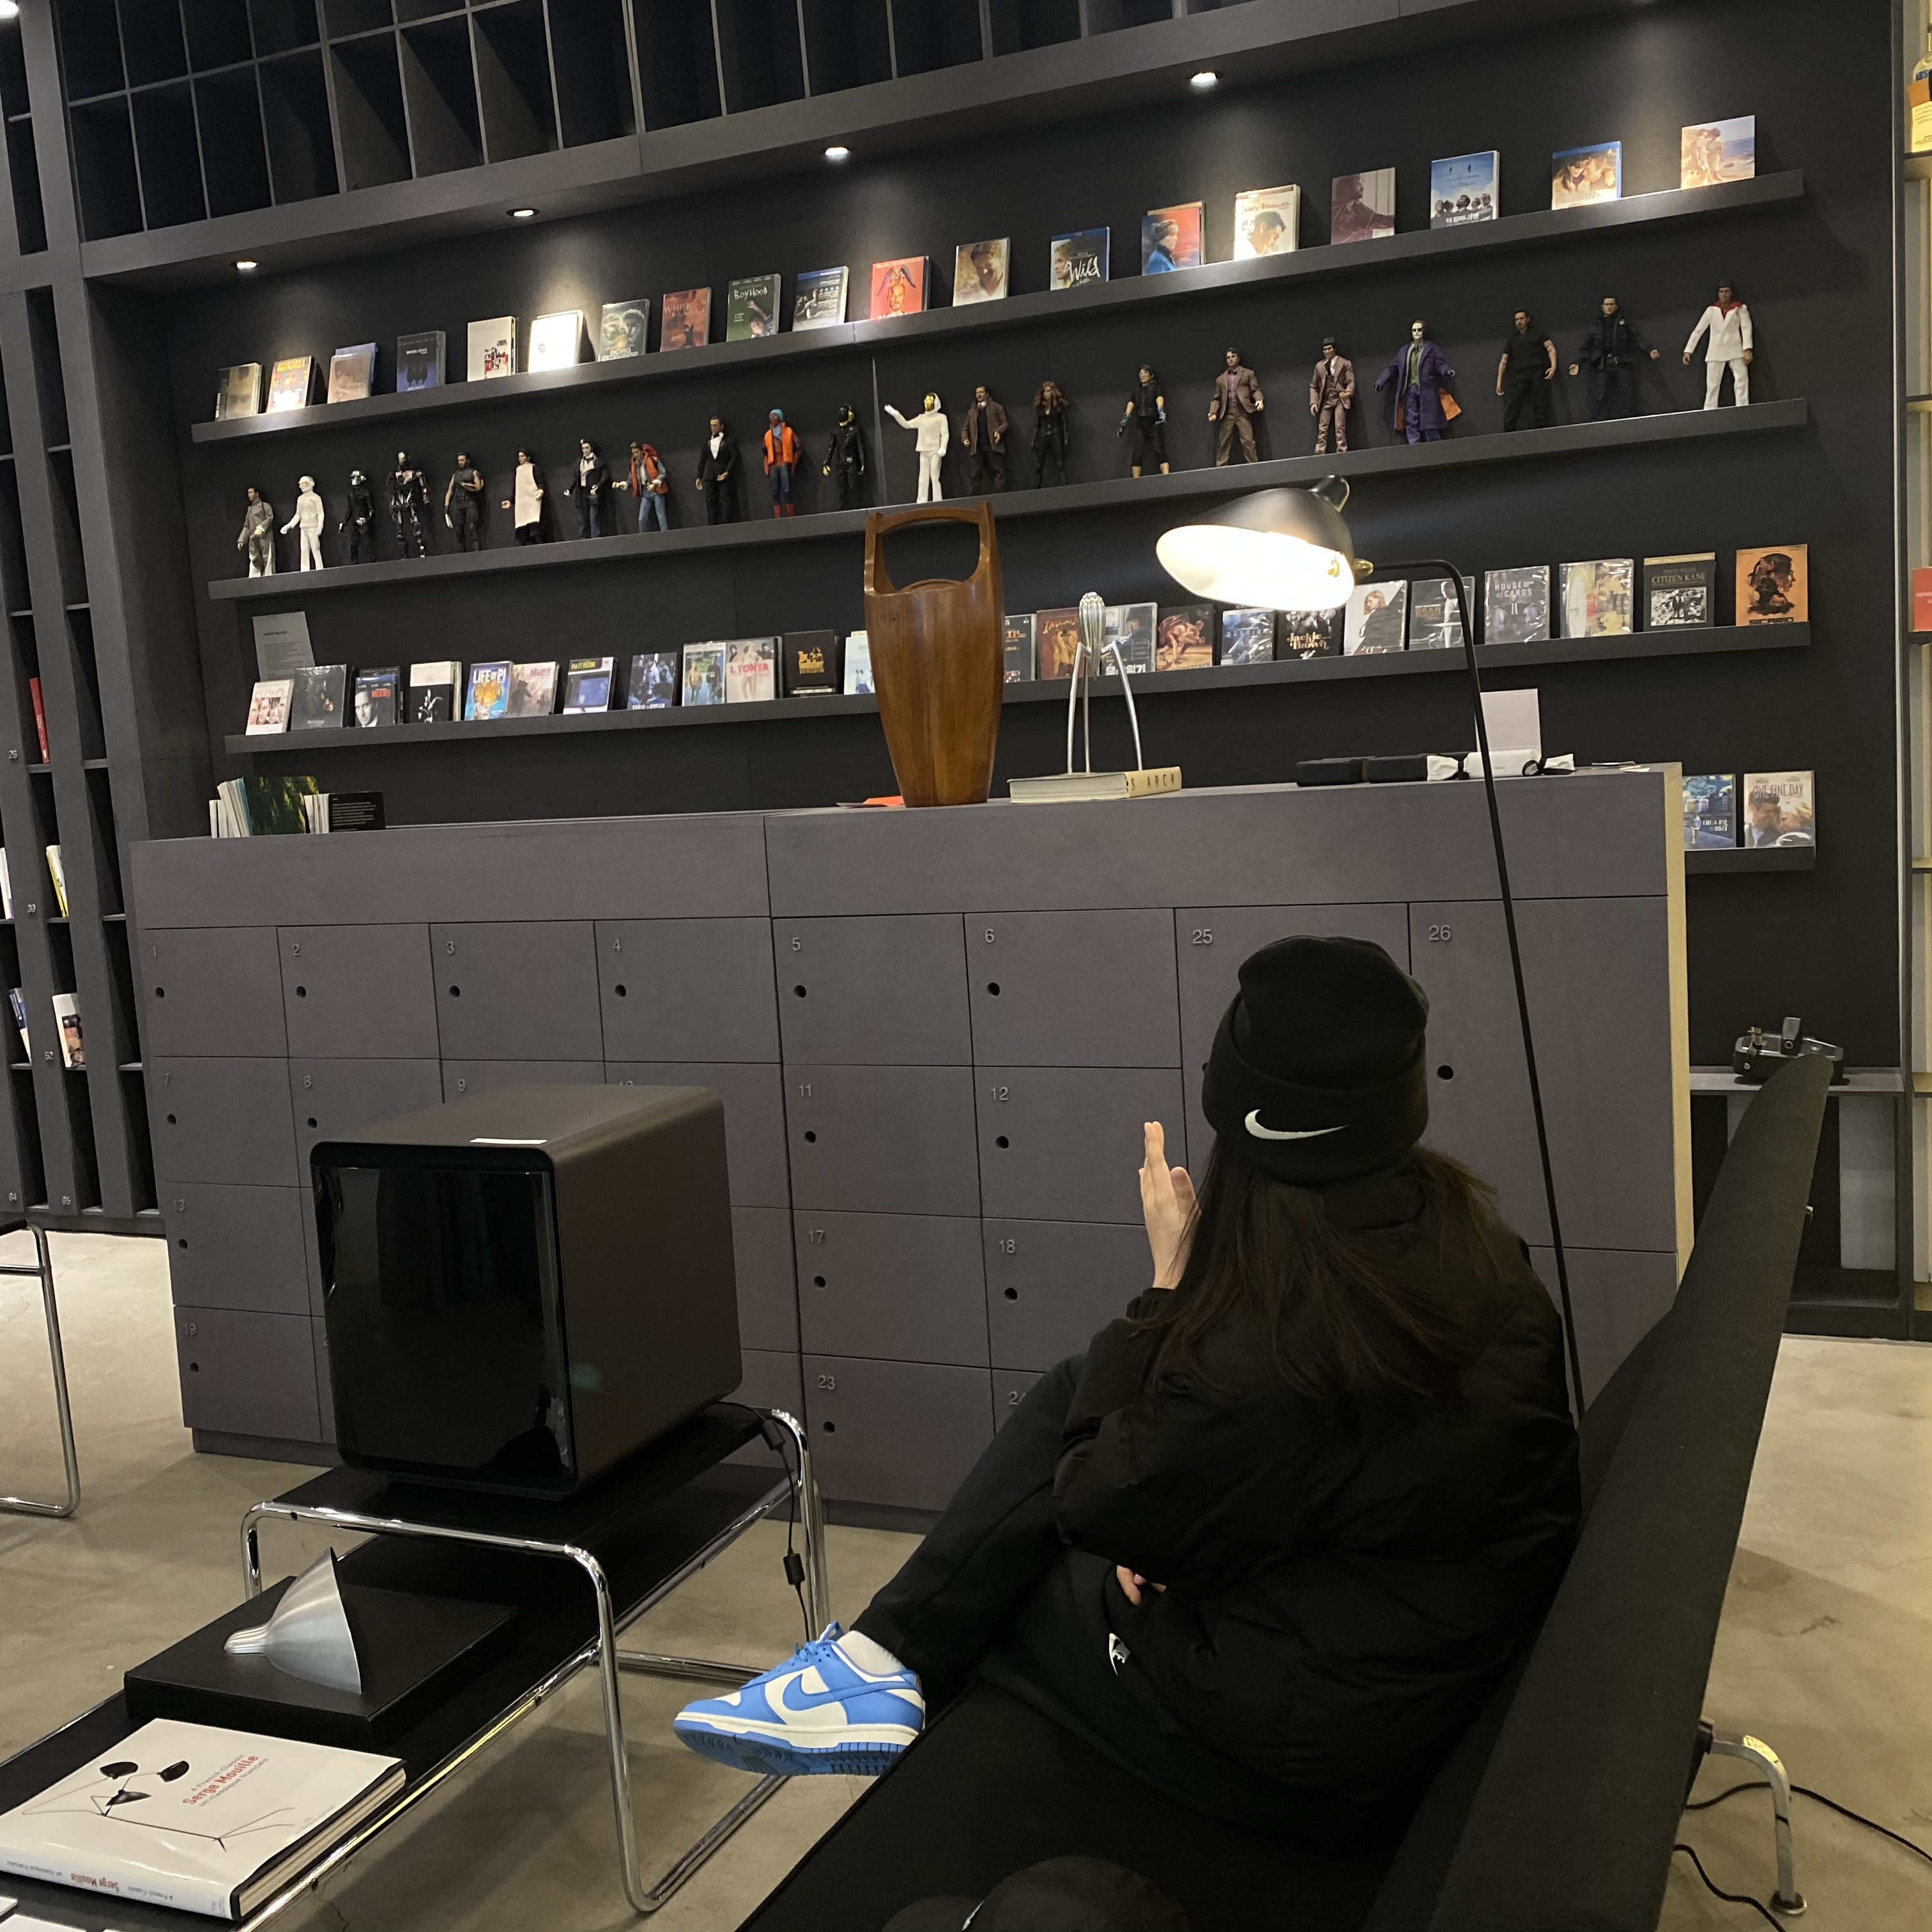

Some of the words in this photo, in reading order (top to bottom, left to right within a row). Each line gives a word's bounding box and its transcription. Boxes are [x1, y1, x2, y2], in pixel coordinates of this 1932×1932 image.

[1063, 256, 1101, 281] Wild
[1495, 581, 1522, 591] HOUSE
[1652, 575, 1683, 584] CITIZEN
[1496, 590, 1503, 599] of
[1505, 588, 1532, 597] CARDS
[1288, 631, 1322, 643] Jackie
[1290, 639, 1329, 650] Brown
[571, 661, 595, 670] PATERSON
[737, 663, 769, 673] TONYA
[473, 670, 491, 684] LIFE
[497, 669, 507, 684] PI
[1752, 785, 1769, 799] ONE
[1770, 784, 1787, 798] FINE
[1789, 783, 1804, 797] DAY
[985, 928, 995, 943] 6
[1192, 929, 1213, 944] 25
[1429, 924, 1451, 941] 26
[293, 944, 300, 956] 2
[447, 941, 454, 954] 3
[613, 939, 621, 951] 4
[792, 937, 801, 951] 5
[153, 945, 157, 958] 1
[44, 1051, 54, 1060] 52
[164, 1073, 171, 1085] 7
[303, 1075, 312, 1087] 8
[458, 1078, 465, 1091] 9
[799, 1084, 811, 1097] 11
[991, 1086, 1008, 1101] 12
[8, 1192, 17, 1201] 64
[61, 1196, 71, 1205] 65
[173, 1199, 185, 1212] 13
[808, 1230, 824, 1243] 17
[999, 1239, 1015, 1254] 18
[818, 1375, 835, 1390] 23
[182, 1784, 220, 1805] Serge
[214, 1756, 259, 1784] Mouille
[70, 1873, 97, 1887] Mouille
[98, 1877, 119, 1892] Serge
